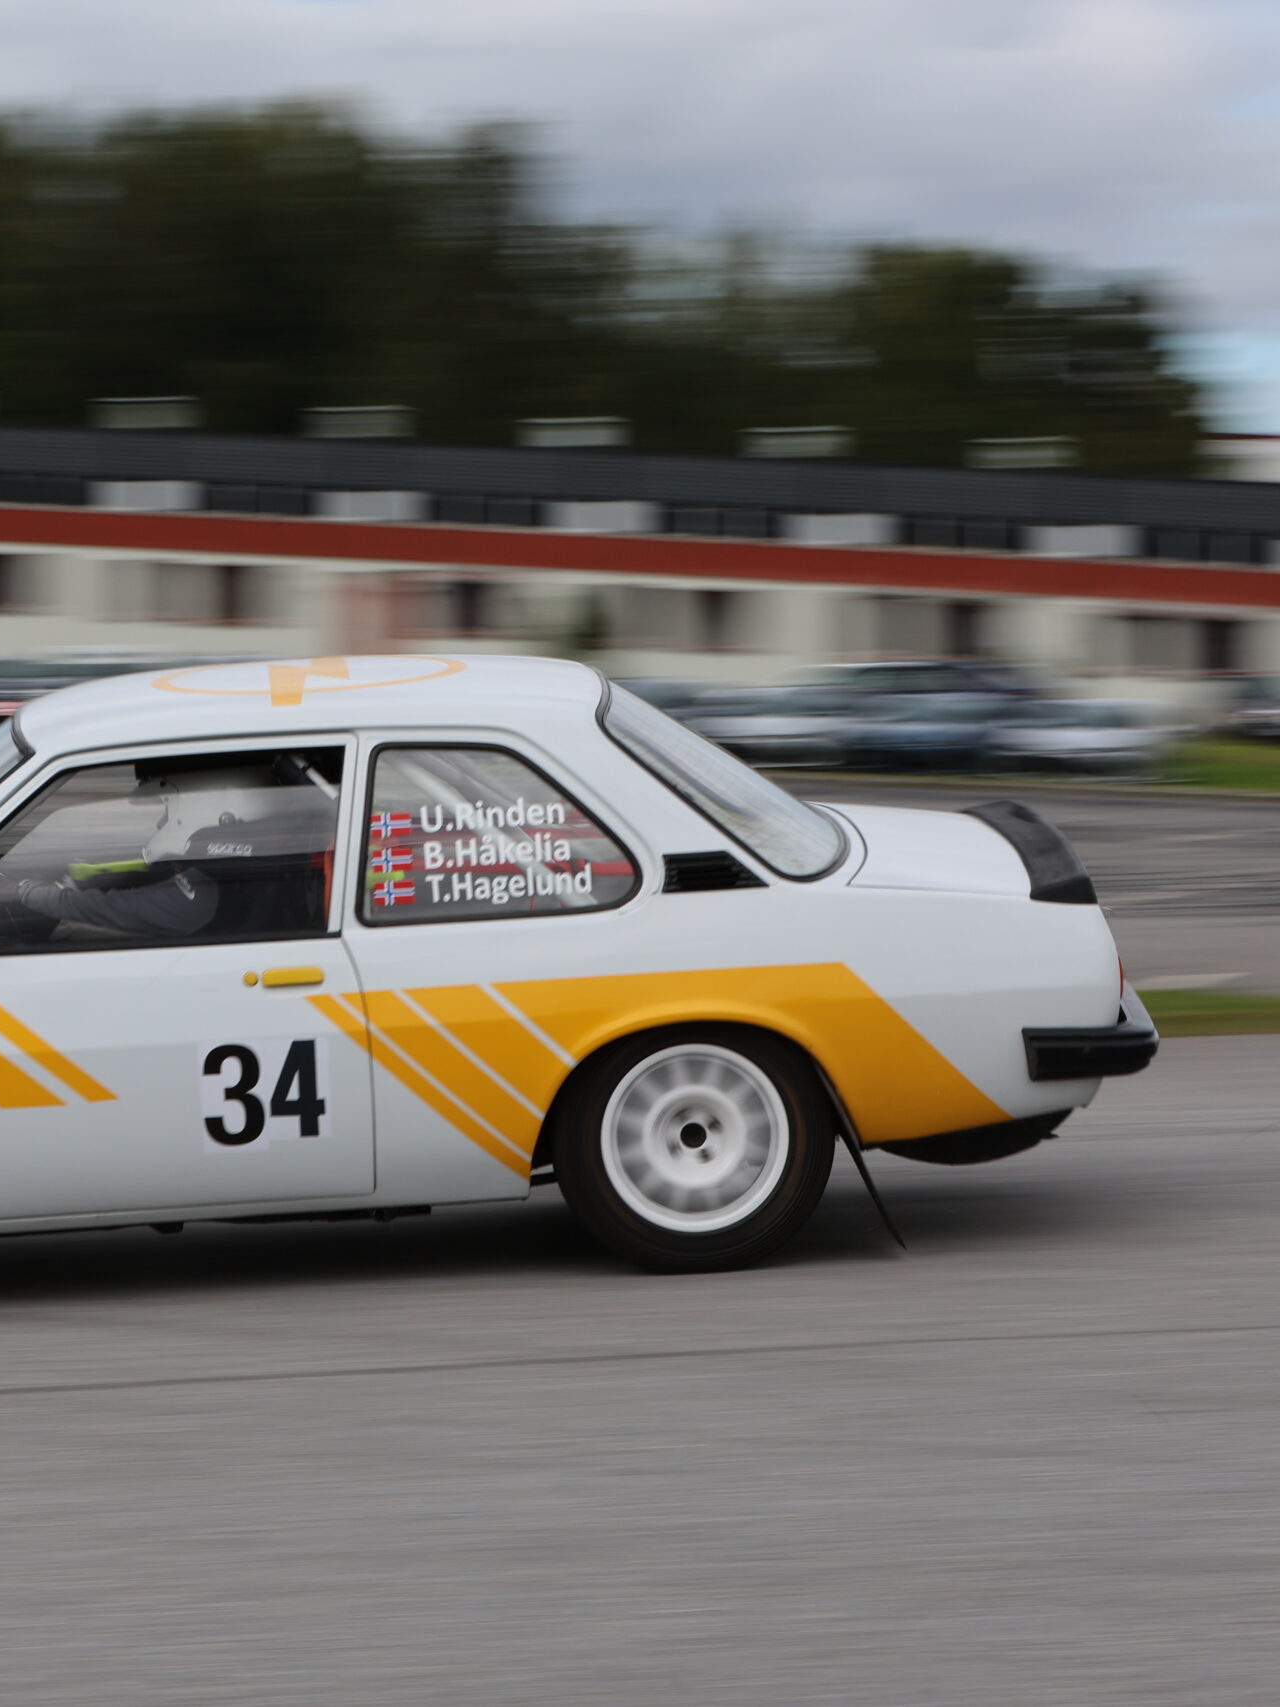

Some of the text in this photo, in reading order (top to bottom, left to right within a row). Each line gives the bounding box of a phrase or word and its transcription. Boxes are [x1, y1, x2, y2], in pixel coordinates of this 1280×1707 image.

[420, 798, 565, 833] U.Rinden
[423, 832, 571, 870] B.Håkelia
[425, 862, 592, 905] T.Hagelund
[203, 1039, 326, 1146] 34
